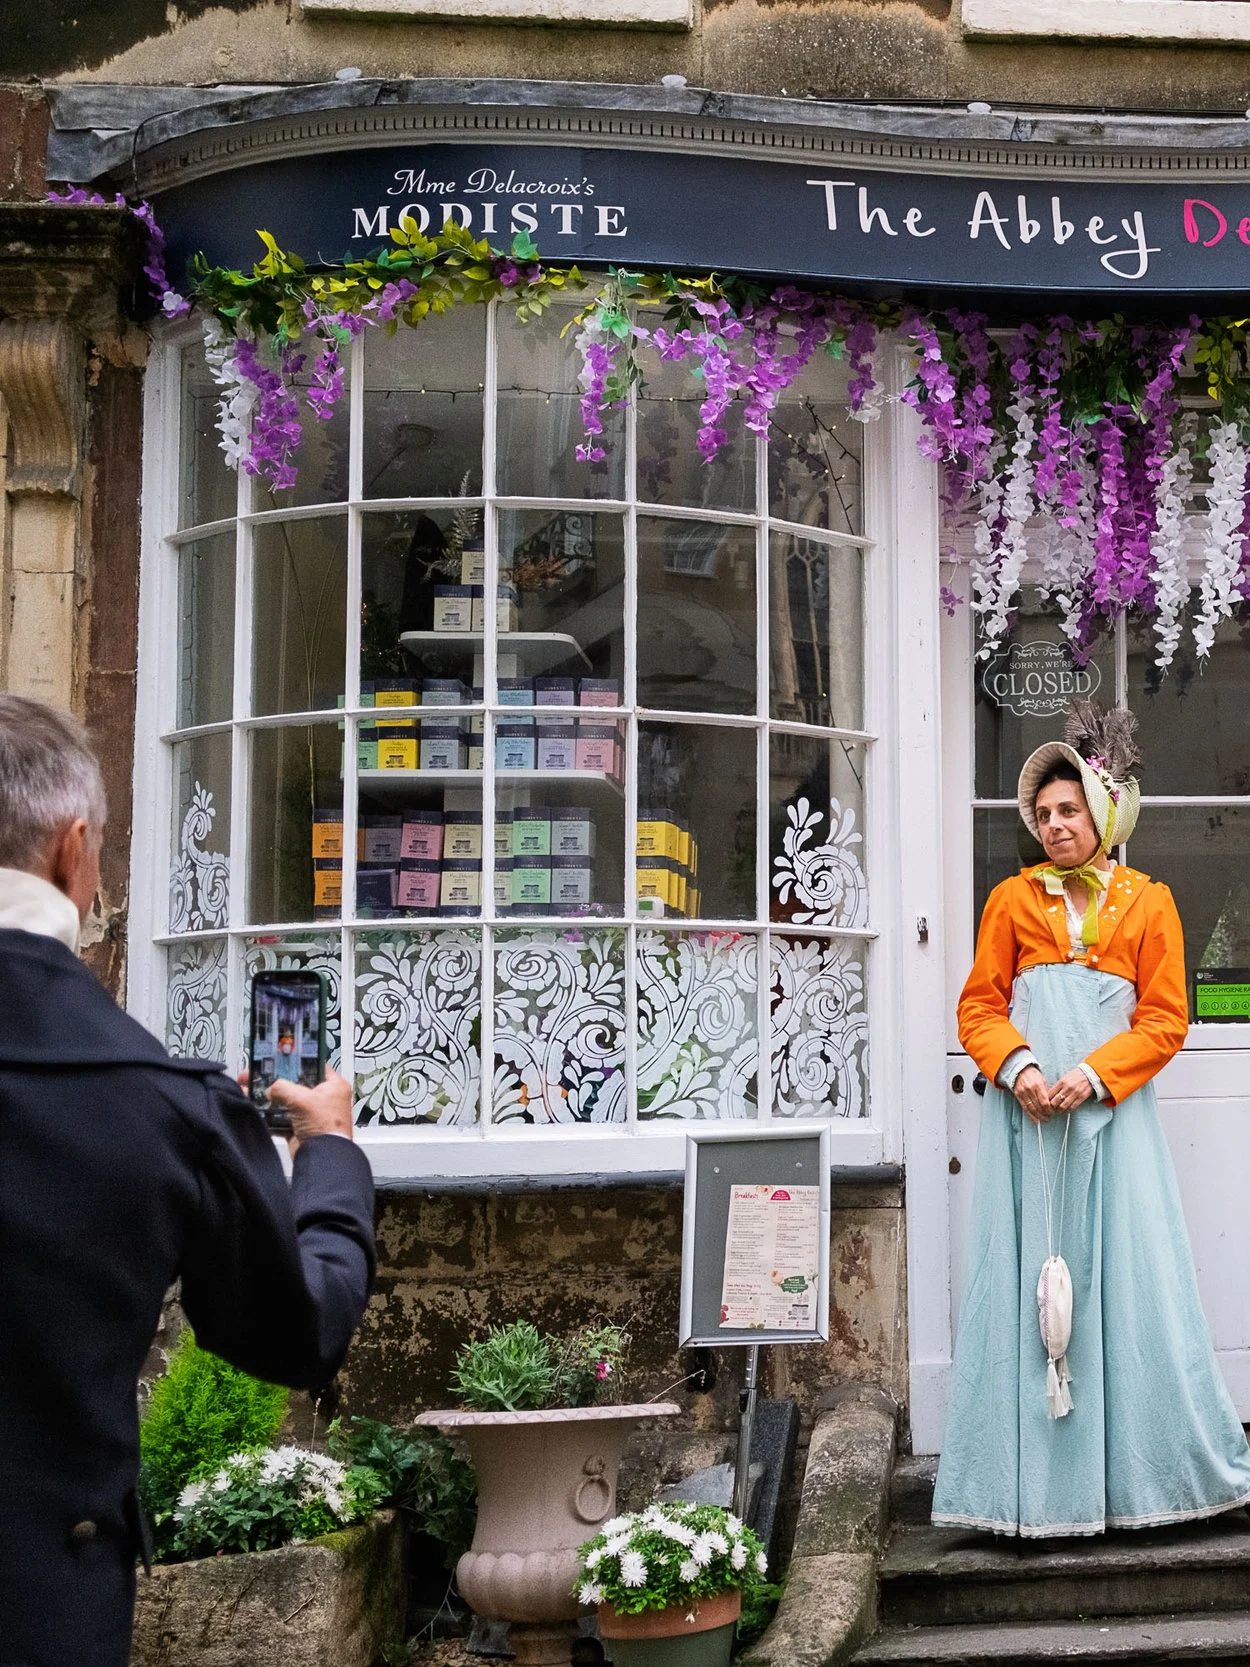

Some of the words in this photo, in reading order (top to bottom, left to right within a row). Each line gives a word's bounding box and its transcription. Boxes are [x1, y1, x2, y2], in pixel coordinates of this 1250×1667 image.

[387, 169, 456, 195] Mme
[463, 168, 595, 196] Delacroix's
[351, 202, 628, 239] MODISTE
[806, 180, 937, 239] The
[967, 191, 1162, 279] Abbey
[993, 671, 1092, 697] CLOSED
